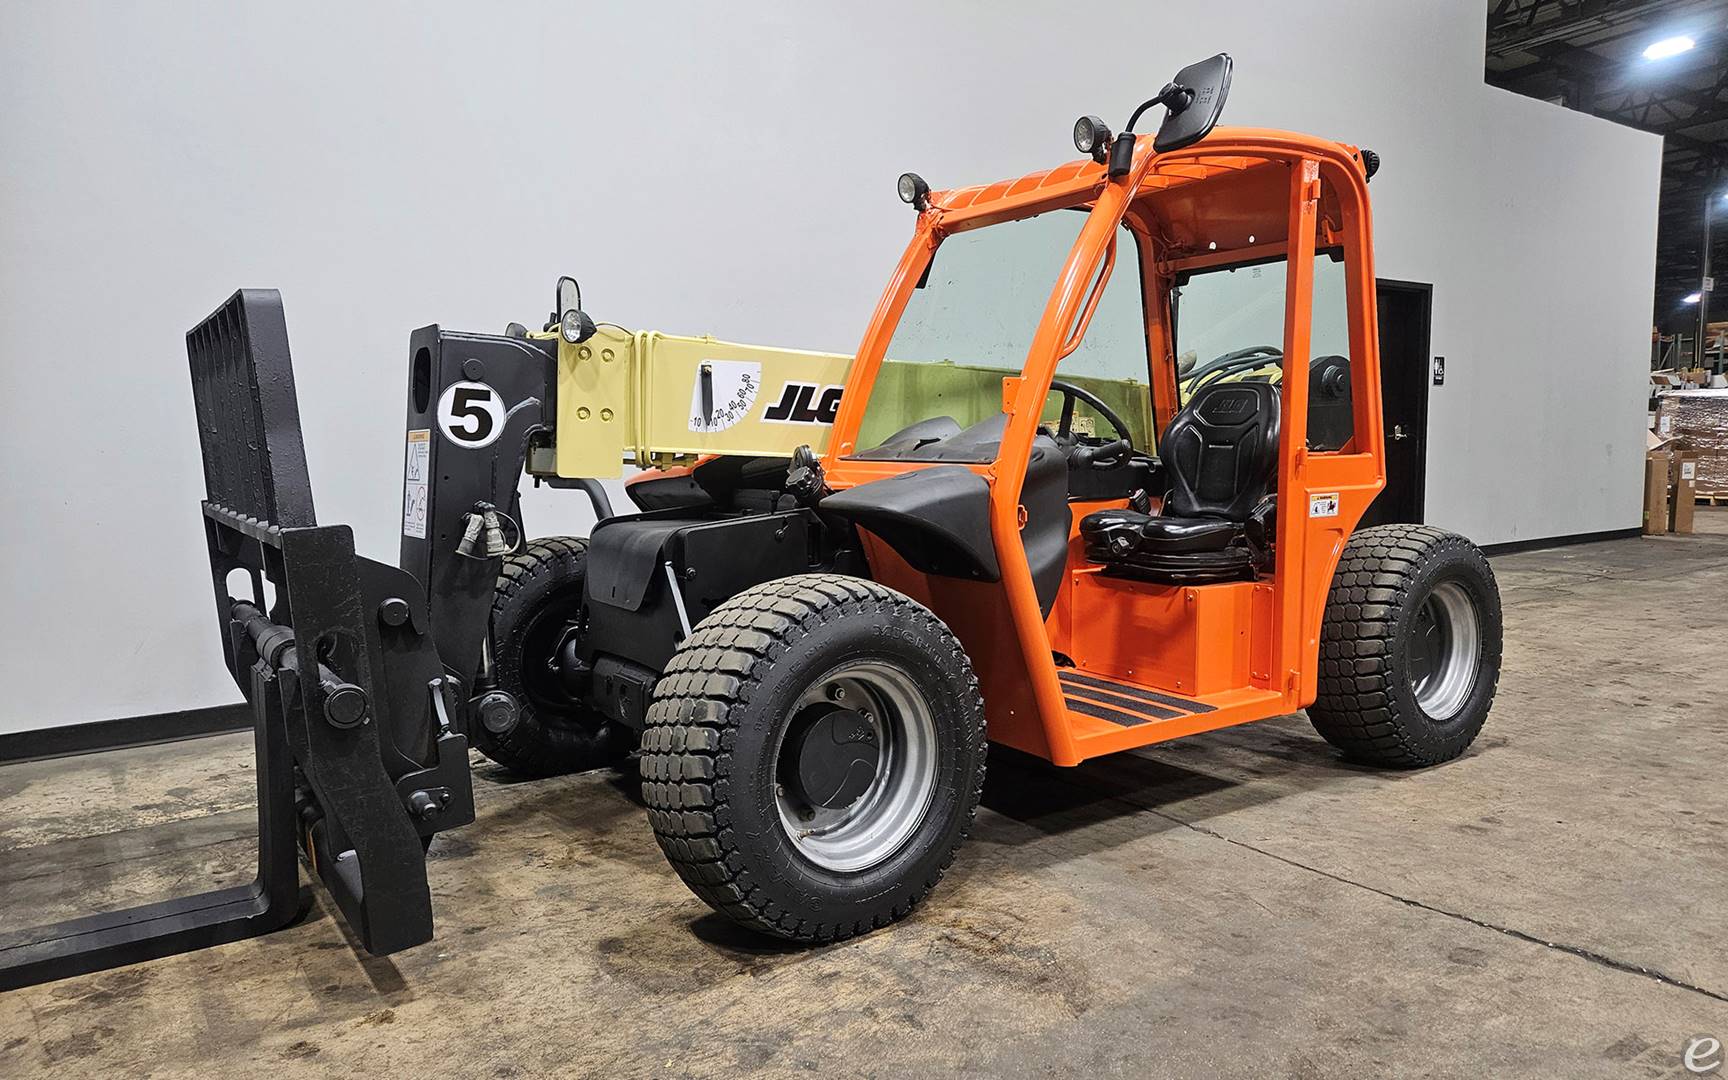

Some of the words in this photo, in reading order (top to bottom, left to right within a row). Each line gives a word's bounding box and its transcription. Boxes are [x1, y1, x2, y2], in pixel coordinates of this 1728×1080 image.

[741, 374, 751, 384] 80
[737, 388, 747, 399] 60
[745, 383, 755, 393] 70
[728, 400, 738, 411] 40
[737, 399, 747, 410] 50
[764, 385, 844, 423] JLG
[449, 387, 493, 442] 5
[715, 408, 725, 419] 20
[725, 411, 734, 422] 30
